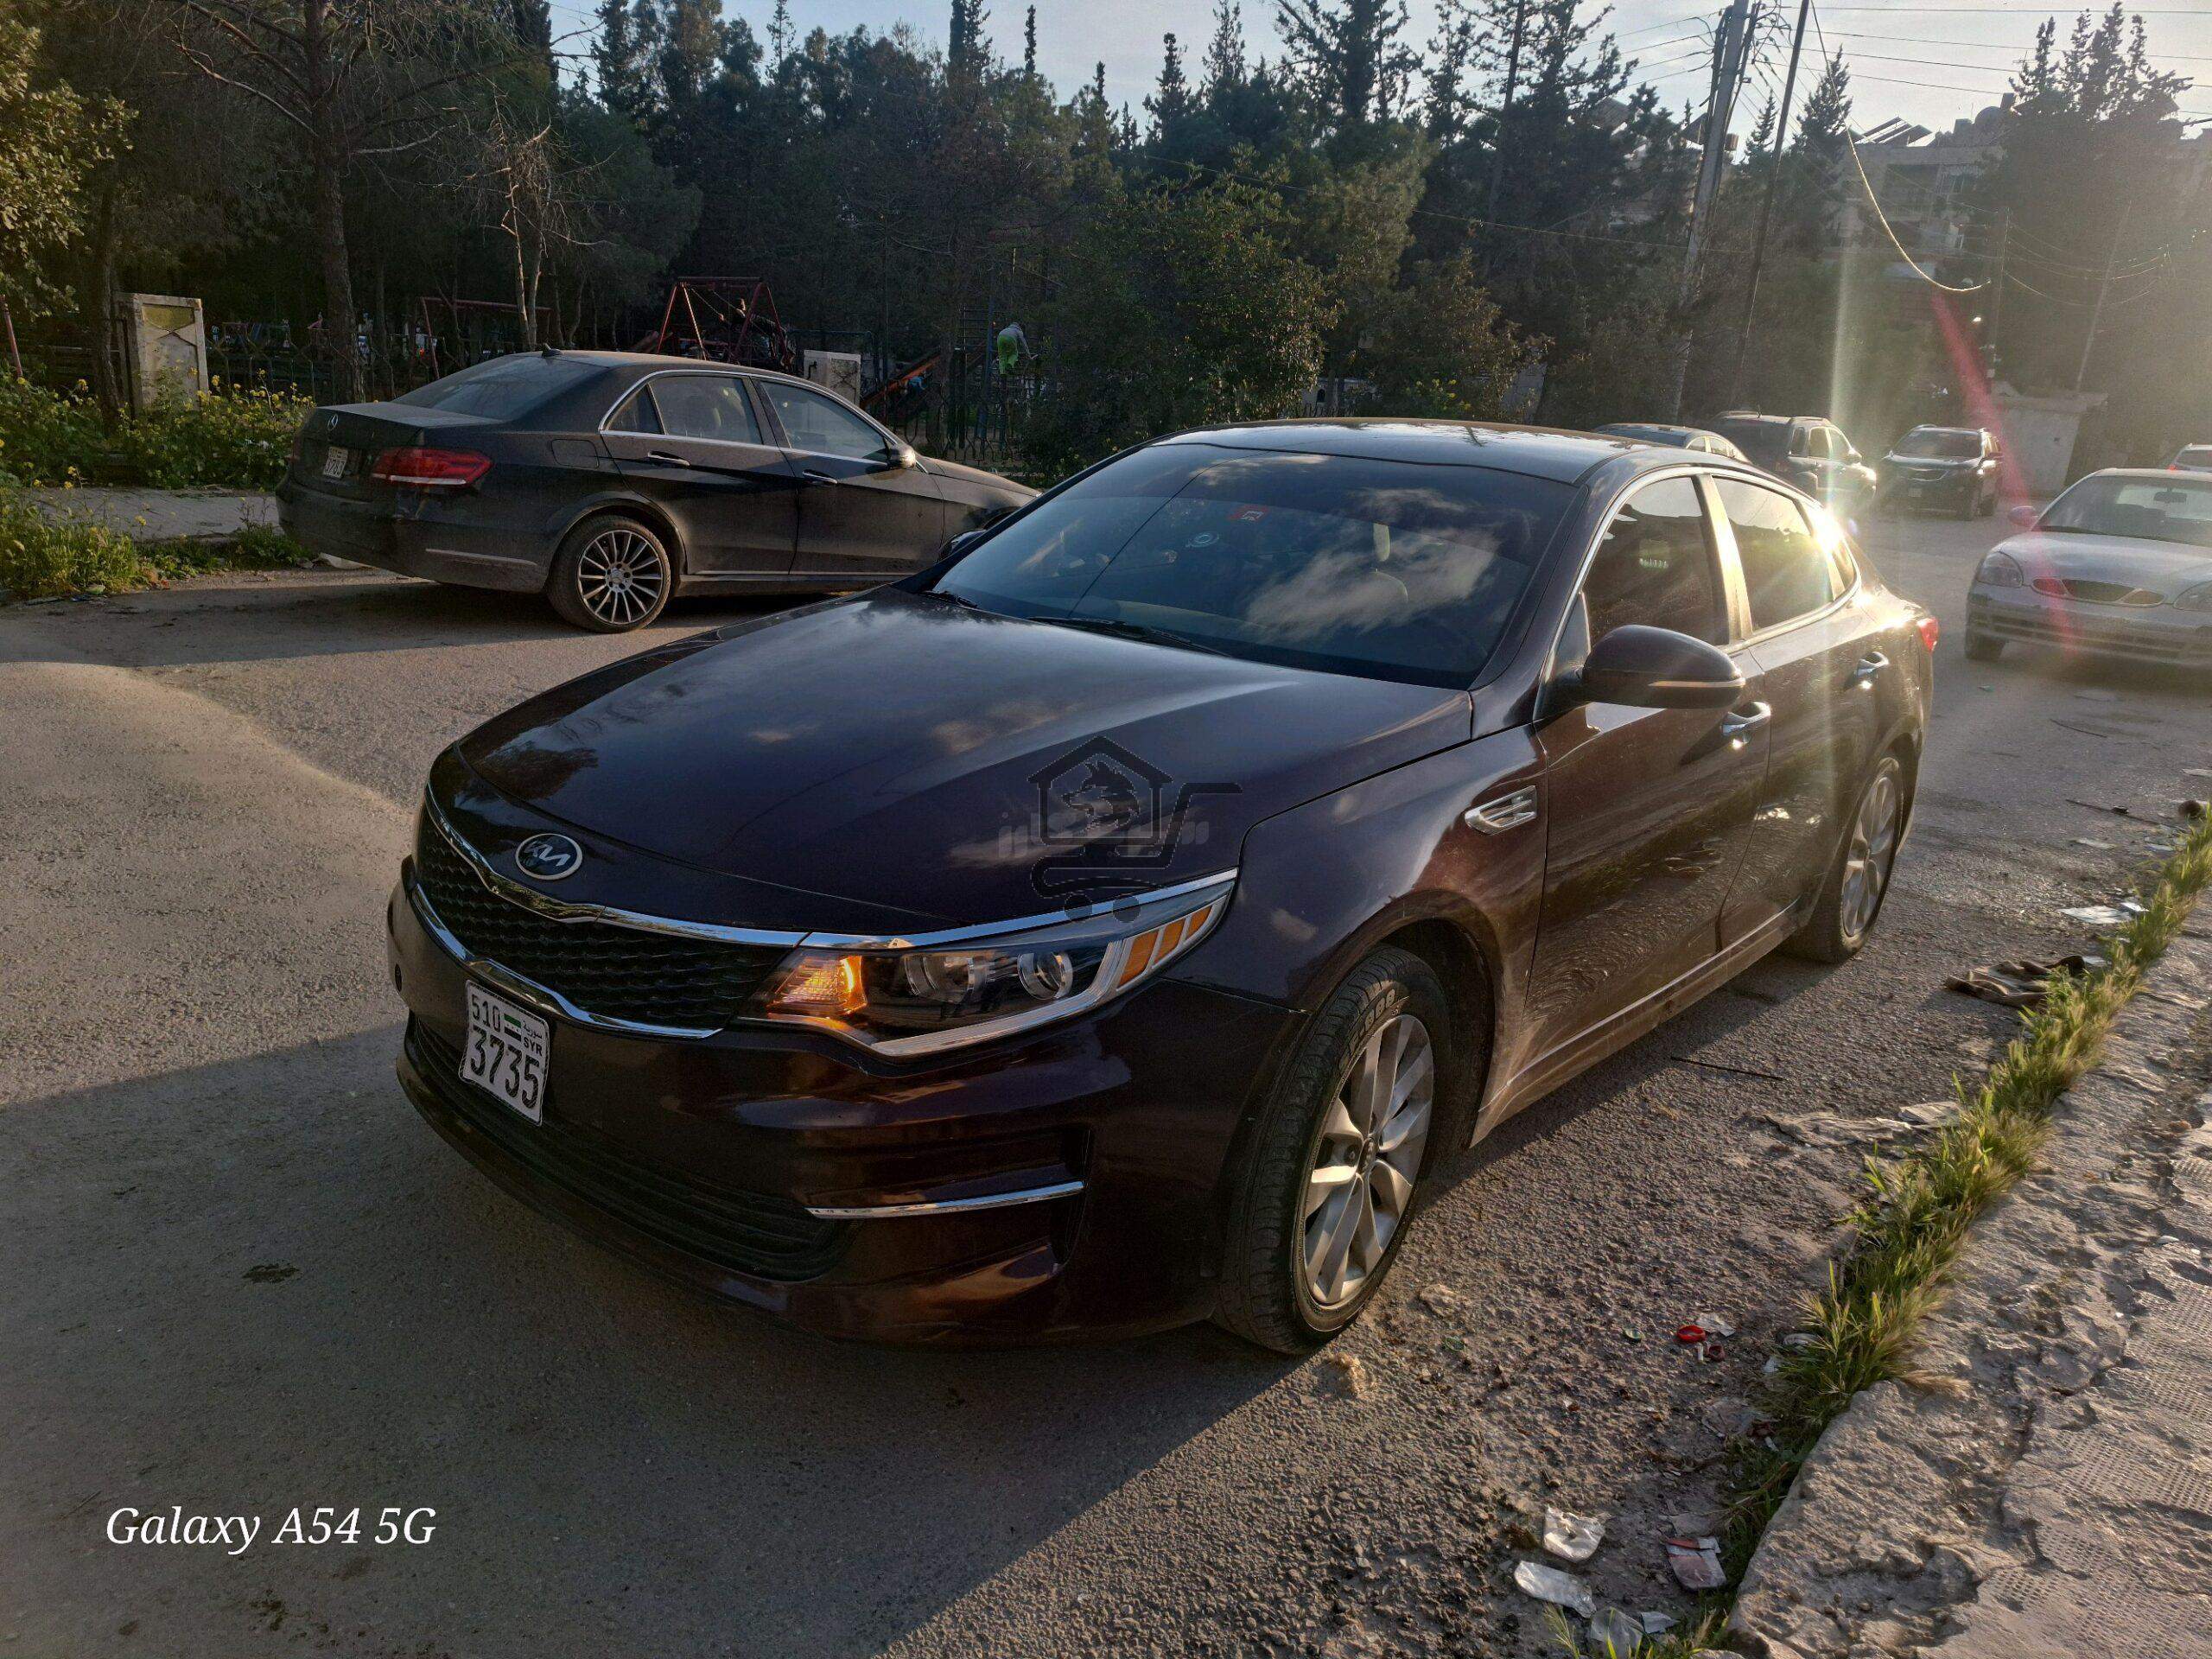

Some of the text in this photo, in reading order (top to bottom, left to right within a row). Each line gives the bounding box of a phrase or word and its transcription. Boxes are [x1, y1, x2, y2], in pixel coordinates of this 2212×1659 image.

[471, 994, 501, 1033] 510
[470, 1025, 540, 1109] 3735
[524, 1037, 543, 1058] SYR
